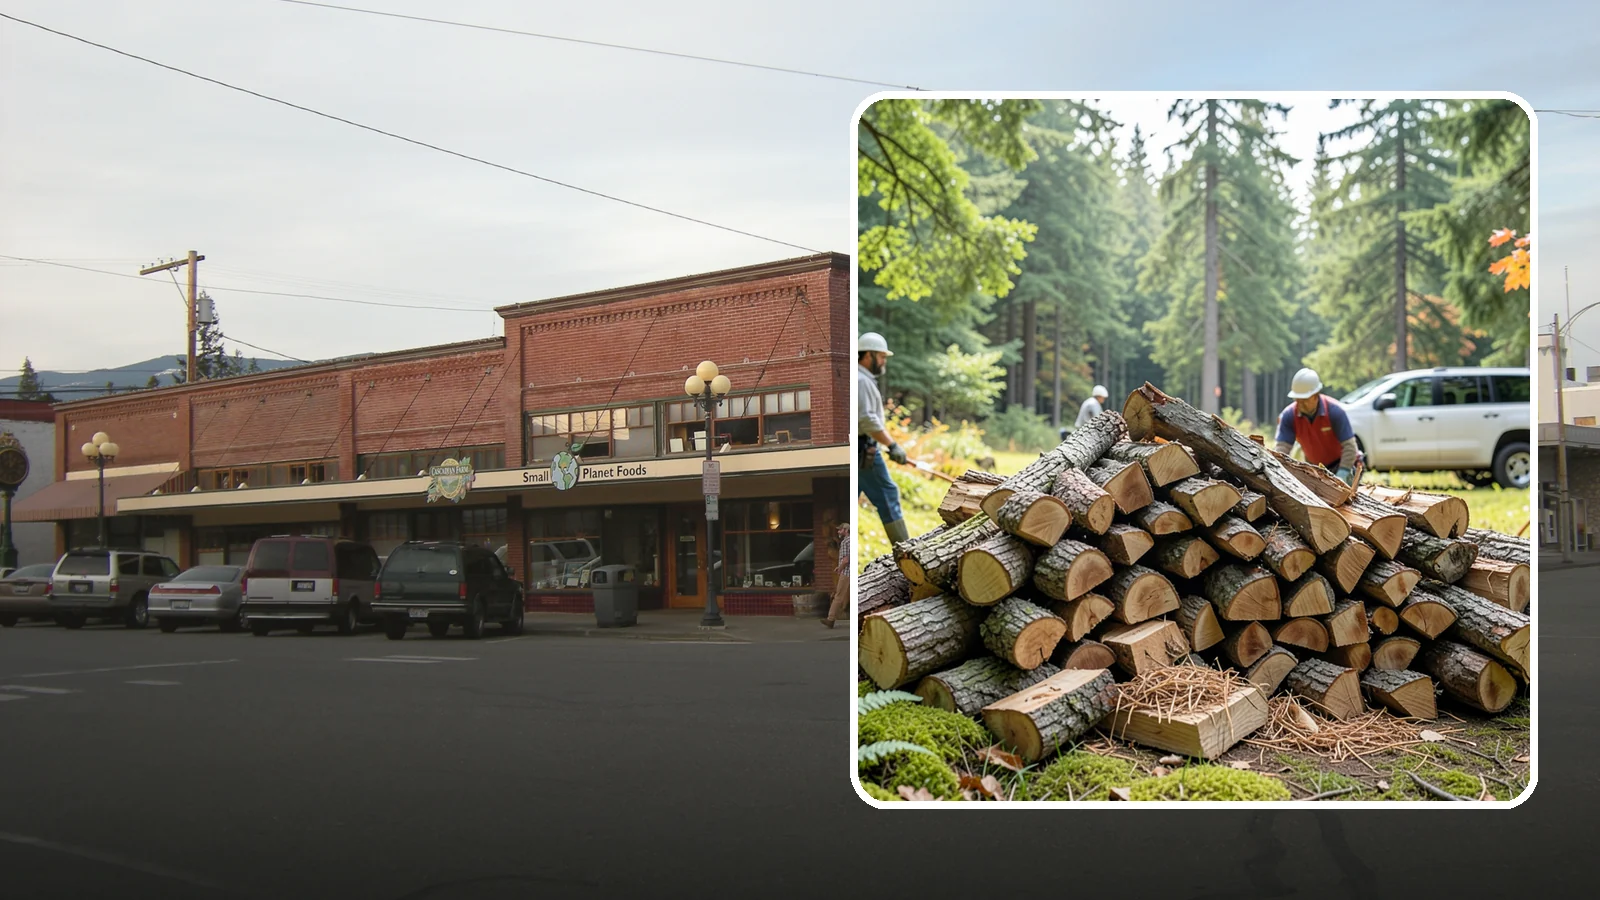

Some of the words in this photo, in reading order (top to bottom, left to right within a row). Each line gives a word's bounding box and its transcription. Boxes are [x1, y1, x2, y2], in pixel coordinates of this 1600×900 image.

[523, 471, 549, 483] Small
[582, 467, 614, 479] Planet
[617, 464, 647, 477] Foods
